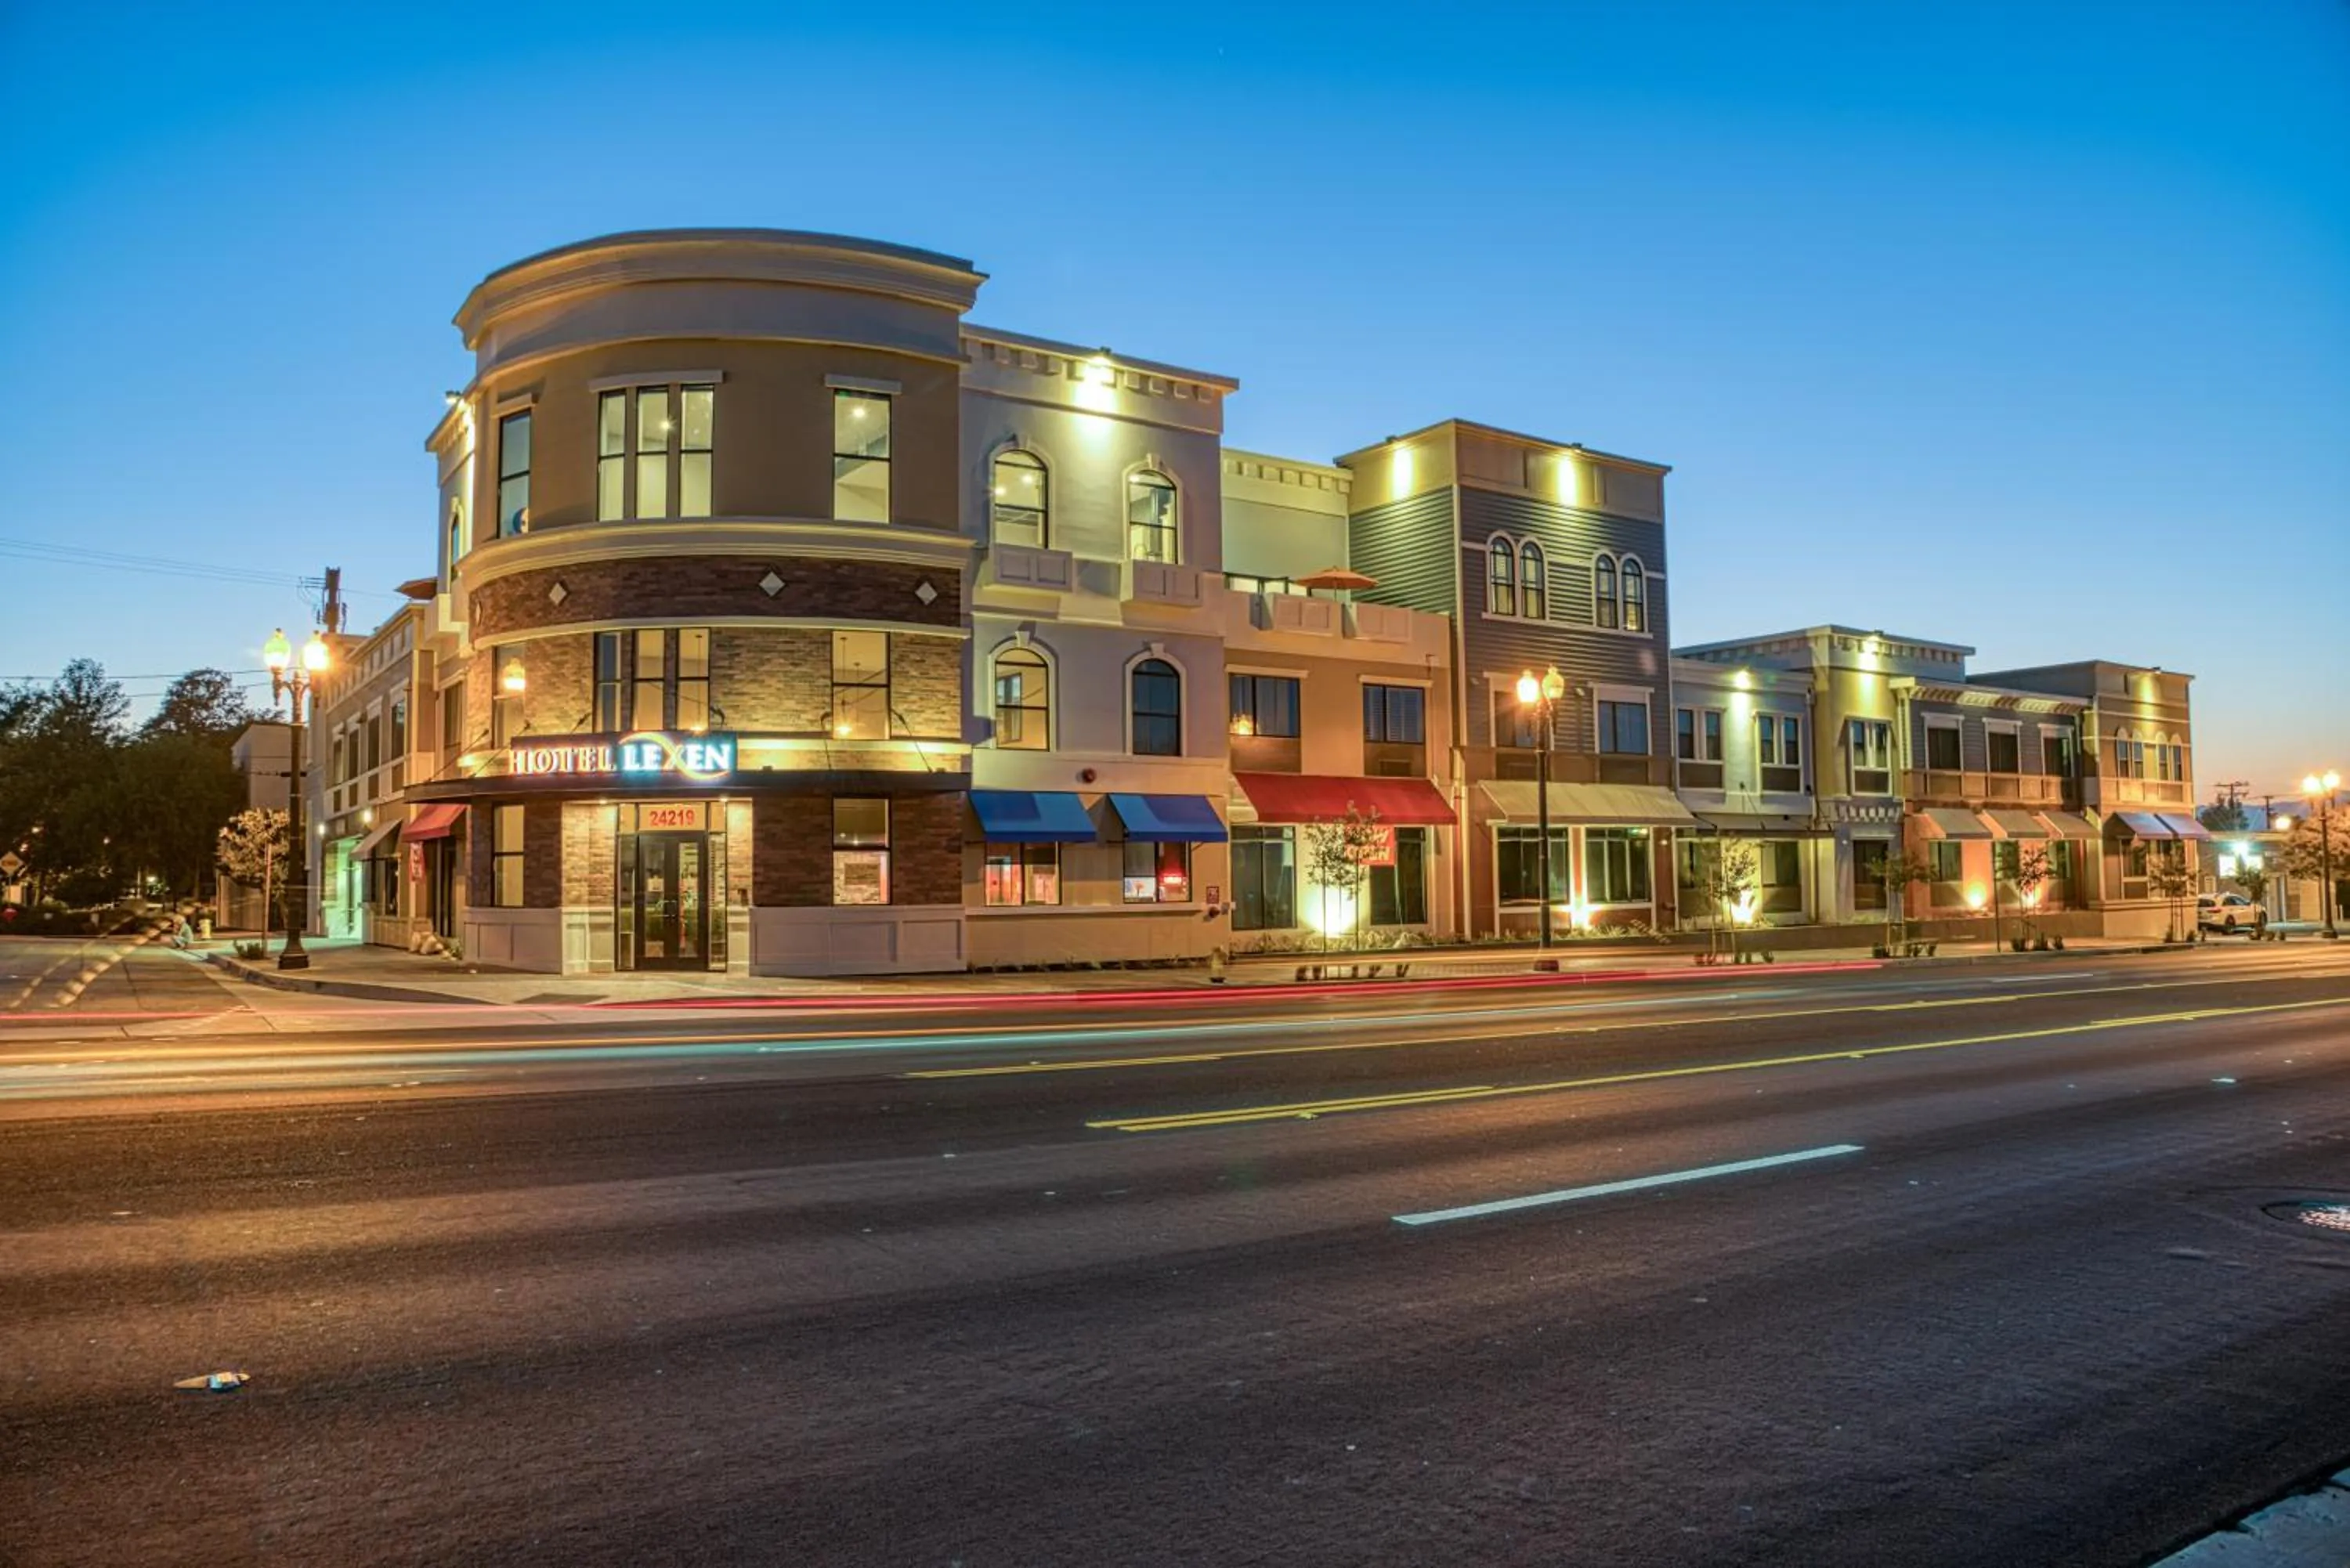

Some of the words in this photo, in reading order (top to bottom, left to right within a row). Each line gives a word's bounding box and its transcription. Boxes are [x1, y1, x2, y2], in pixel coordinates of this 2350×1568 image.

[508, 745, 616, 774] HOTEL
[620, 737, 730, 776] LEXEN
[649, 809, 696, 827] 24219
